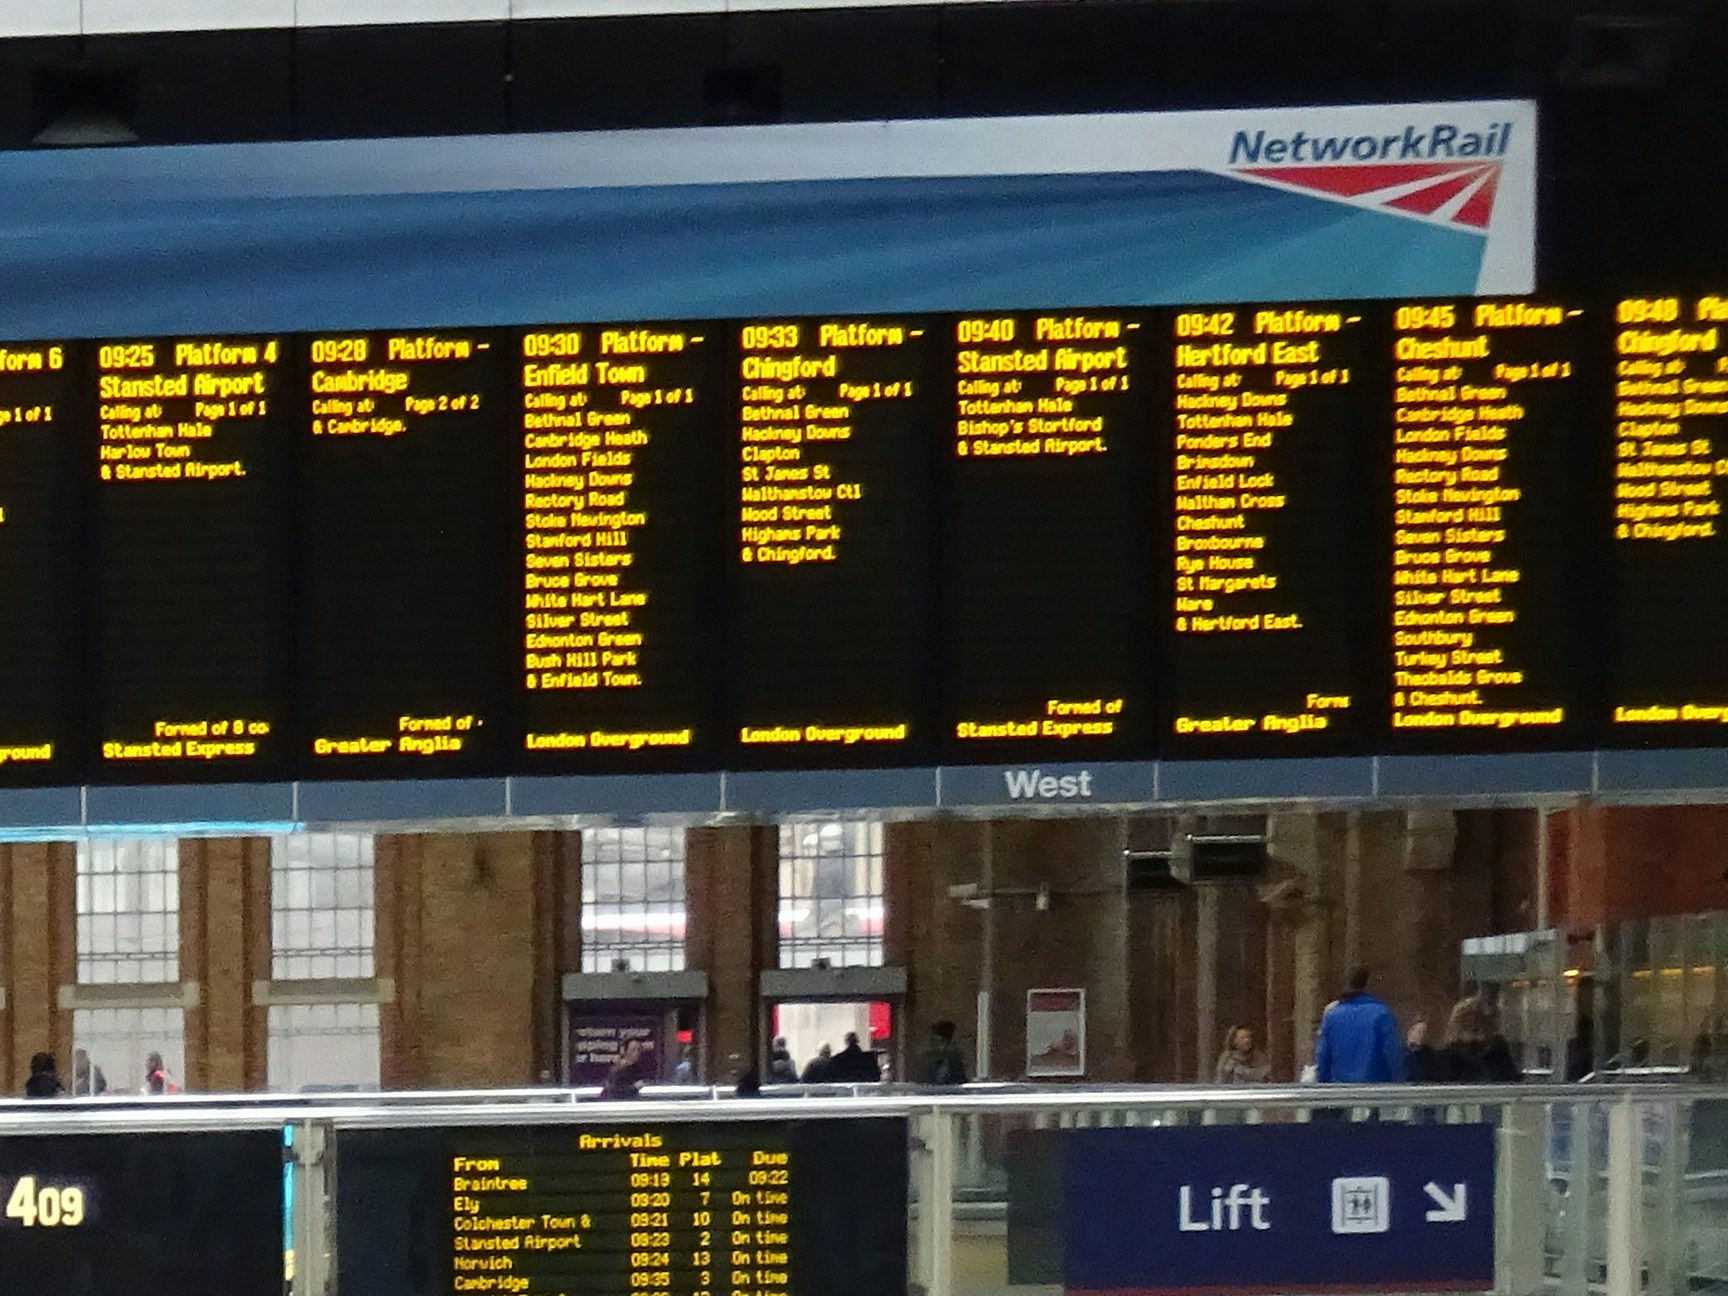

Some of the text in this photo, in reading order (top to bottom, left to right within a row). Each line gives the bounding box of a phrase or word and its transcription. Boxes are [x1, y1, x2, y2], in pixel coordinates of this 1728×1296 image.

[1229, 122, 1514, 164] NetworkRail
[1177, 311, 1339, 336] 09:42 Platform
[1396, 303, 1561, 329] 09:45 Platform
[742, 324, 902, 349] 09:33 Platform
[958, 317, 1119, 342] 09:40 Platform
[100, 341, 278, 368] 09:25 Platform 4
[312, 337, 470, 362] 09:28 Platform
[523, 330, 682, 356] 09:30 Platform
[1175, 340, 1320, 368] Hertford East
[1396, 335, 1489, 360] Cheshunt
[48, 346, 63, 370] 6
[742, 355, 836, 381] Chingford
[957, 346, 1128, 374] Stansted Airport
[99, 371, 266, 399] Stansted Airport
[312, 369, 408, 393] Cambridge
[523, 361, 646, 388] Enfield Town
[526, 729, 691, 750] London Overground
[1005, 769, 1092, 799] West
[579, 1132, 663, 1149] Arrivals
[453, 1150, 789, 1172] From Time Plat Due
[453, 1196, 480, 1215] Ely
[1179, 1183, 1272, 1233] Lift
